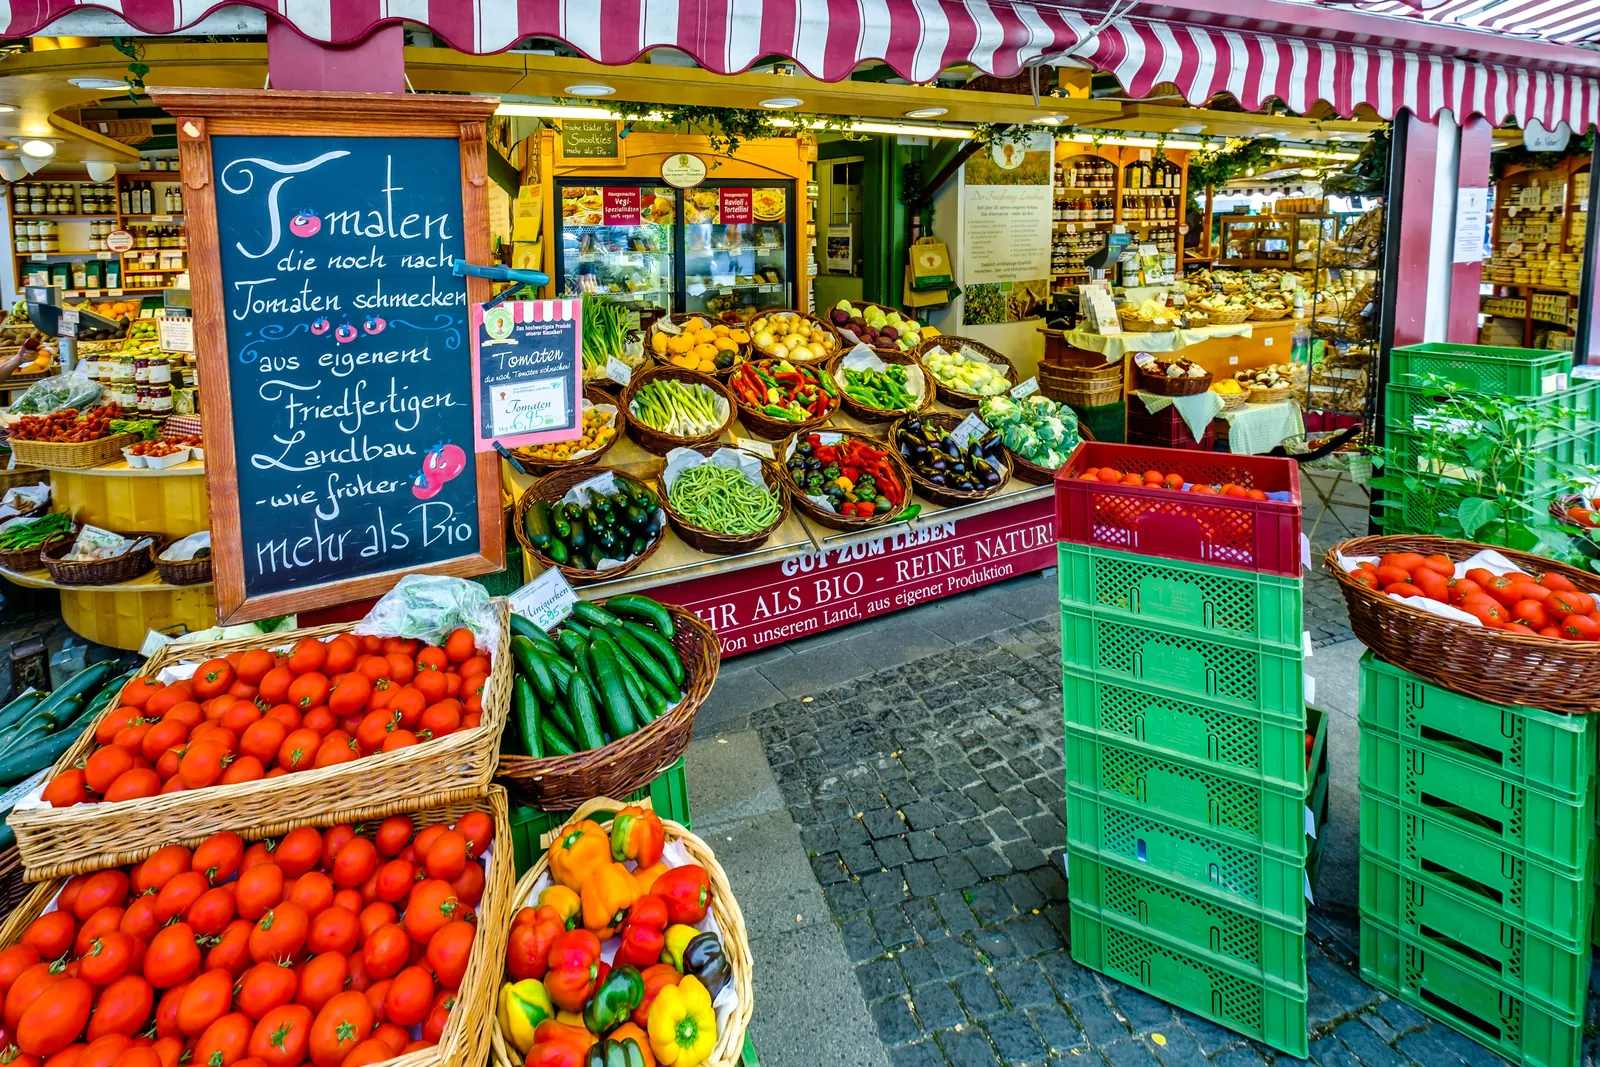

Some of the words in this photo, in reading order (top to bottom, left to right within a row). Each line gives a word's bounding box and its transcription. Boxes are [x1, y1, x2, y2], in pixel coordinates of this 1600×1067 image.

[584, 147, 594, 155] als
[277, 249, 317, 272] die
[327, 245, 388, 271] noch
[401, 243, 454, 270] nach
[232, 277, 342, 321] Tomaten
[352, 275, 467, 309] schmecken
[259, 353, 301, 373] aus
[318, 342, 432, 377] eigenem
[484, 374, 495, 383] die
[495, 371, 511, 380] nach
[512, 367, 539, 379] Tomaten
[492, 348, 564, 370] Tomaten
[258, 377, 456, 435] Friedfertigen
[505, 399, 552, 414] Tomaten
[513, 409, 545, 431] 6,95
[251, 430, 417, 472] Landbau
[256, 517, 354, 575] mehr
[360, 506, 410, 559] als
[408, 501, 473, 549] Bio
[781, 549, 831, 577] GUT
[837, 537, 885, 565] ZUM
[891, 520, 957, 551] LEBEN
[694, 603, 740, 631] HR
[752, 586, 802, 621] ALS
[813, 571, 864, 605] BIO
[895, 544, 966, 583] REINE
[975, 522, 1053, 562] NATUR!
[539, 604, 560, 627] 5,95
[753, 616, 819, 645] unserem
[823, 601, 863, 626] Land,
[867, 597, 891, 614] aus
[895, 582, 944, 607] eigener
[947, 563, 1014, 591] Produktion
